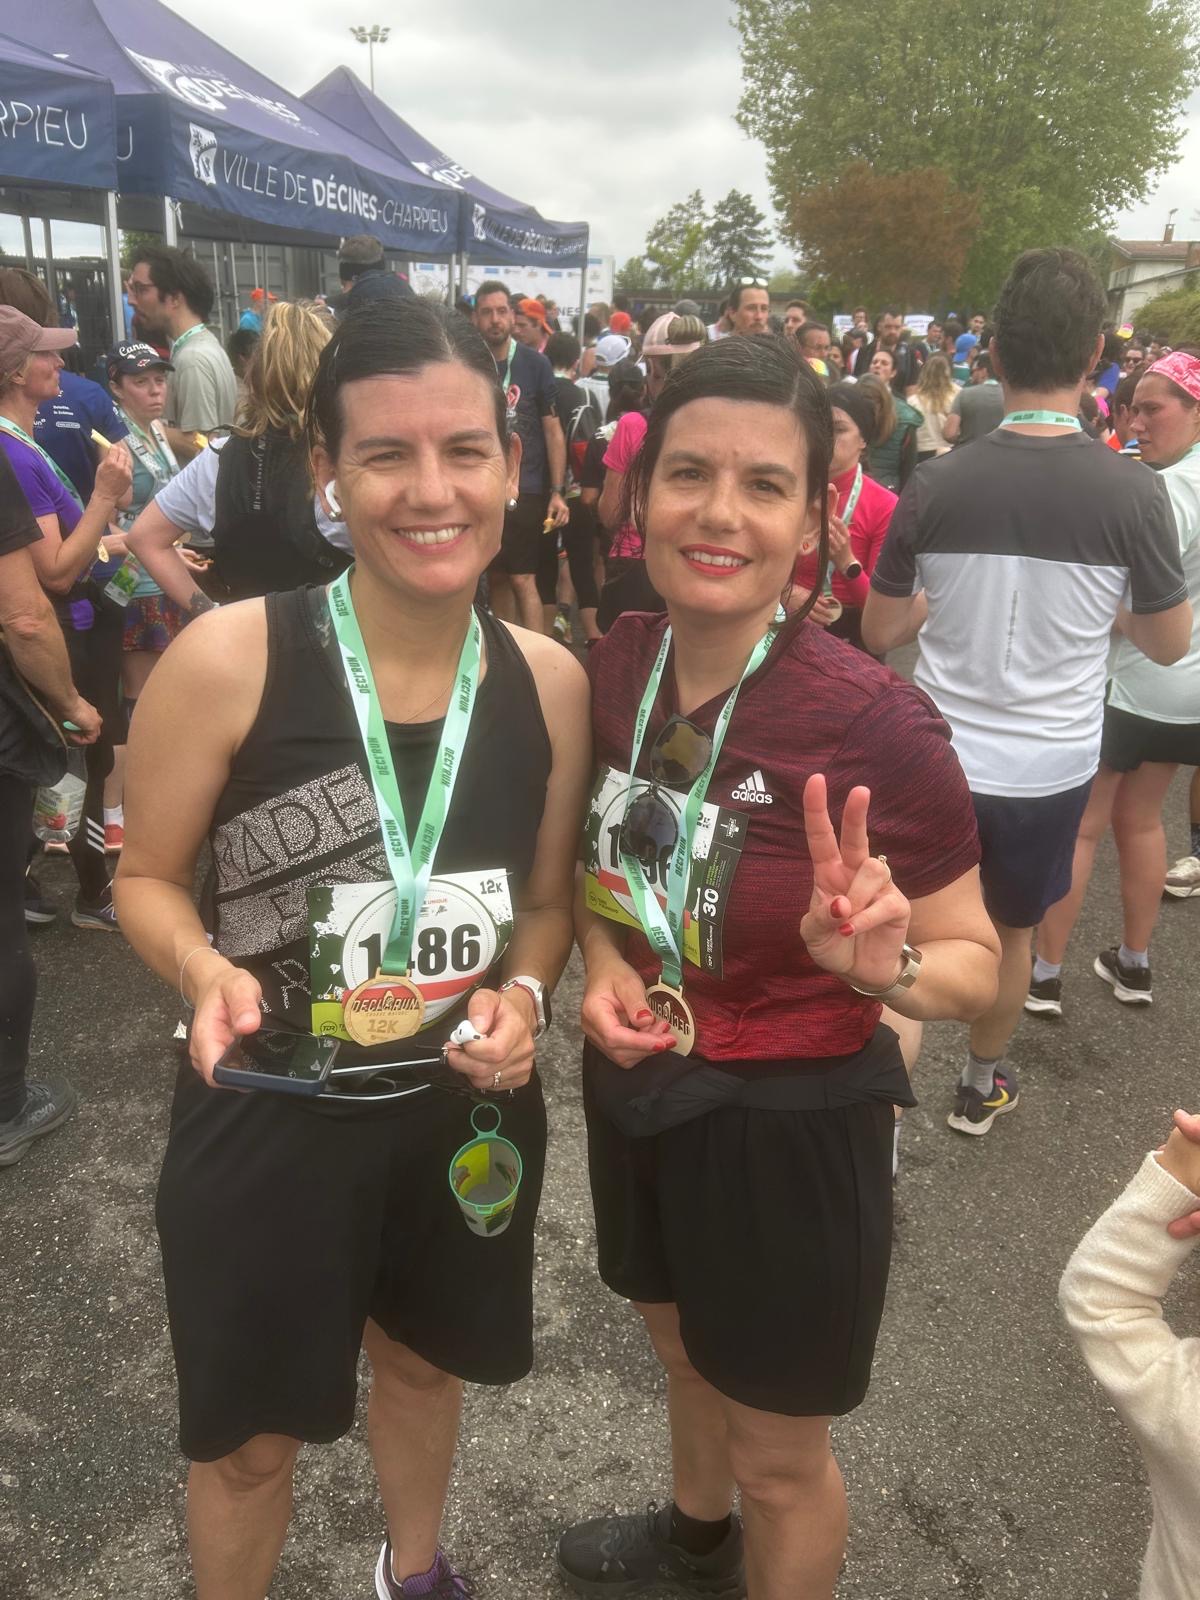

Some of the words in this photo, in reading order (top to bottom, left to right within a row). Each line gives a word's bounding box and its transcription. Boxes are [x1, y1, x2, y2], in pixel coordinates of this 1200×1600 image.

[223, 149, 278, 198] VILLE
[283, 170, 308, 205] DE
[119, 343, 159, 357] Cana
[731, 789, 773, 804] adidas
[384, 819, 405, 857] DECI'RUN
[358, 924, 481, 980] 186
[366, 1019, 399, 1034] 12K
